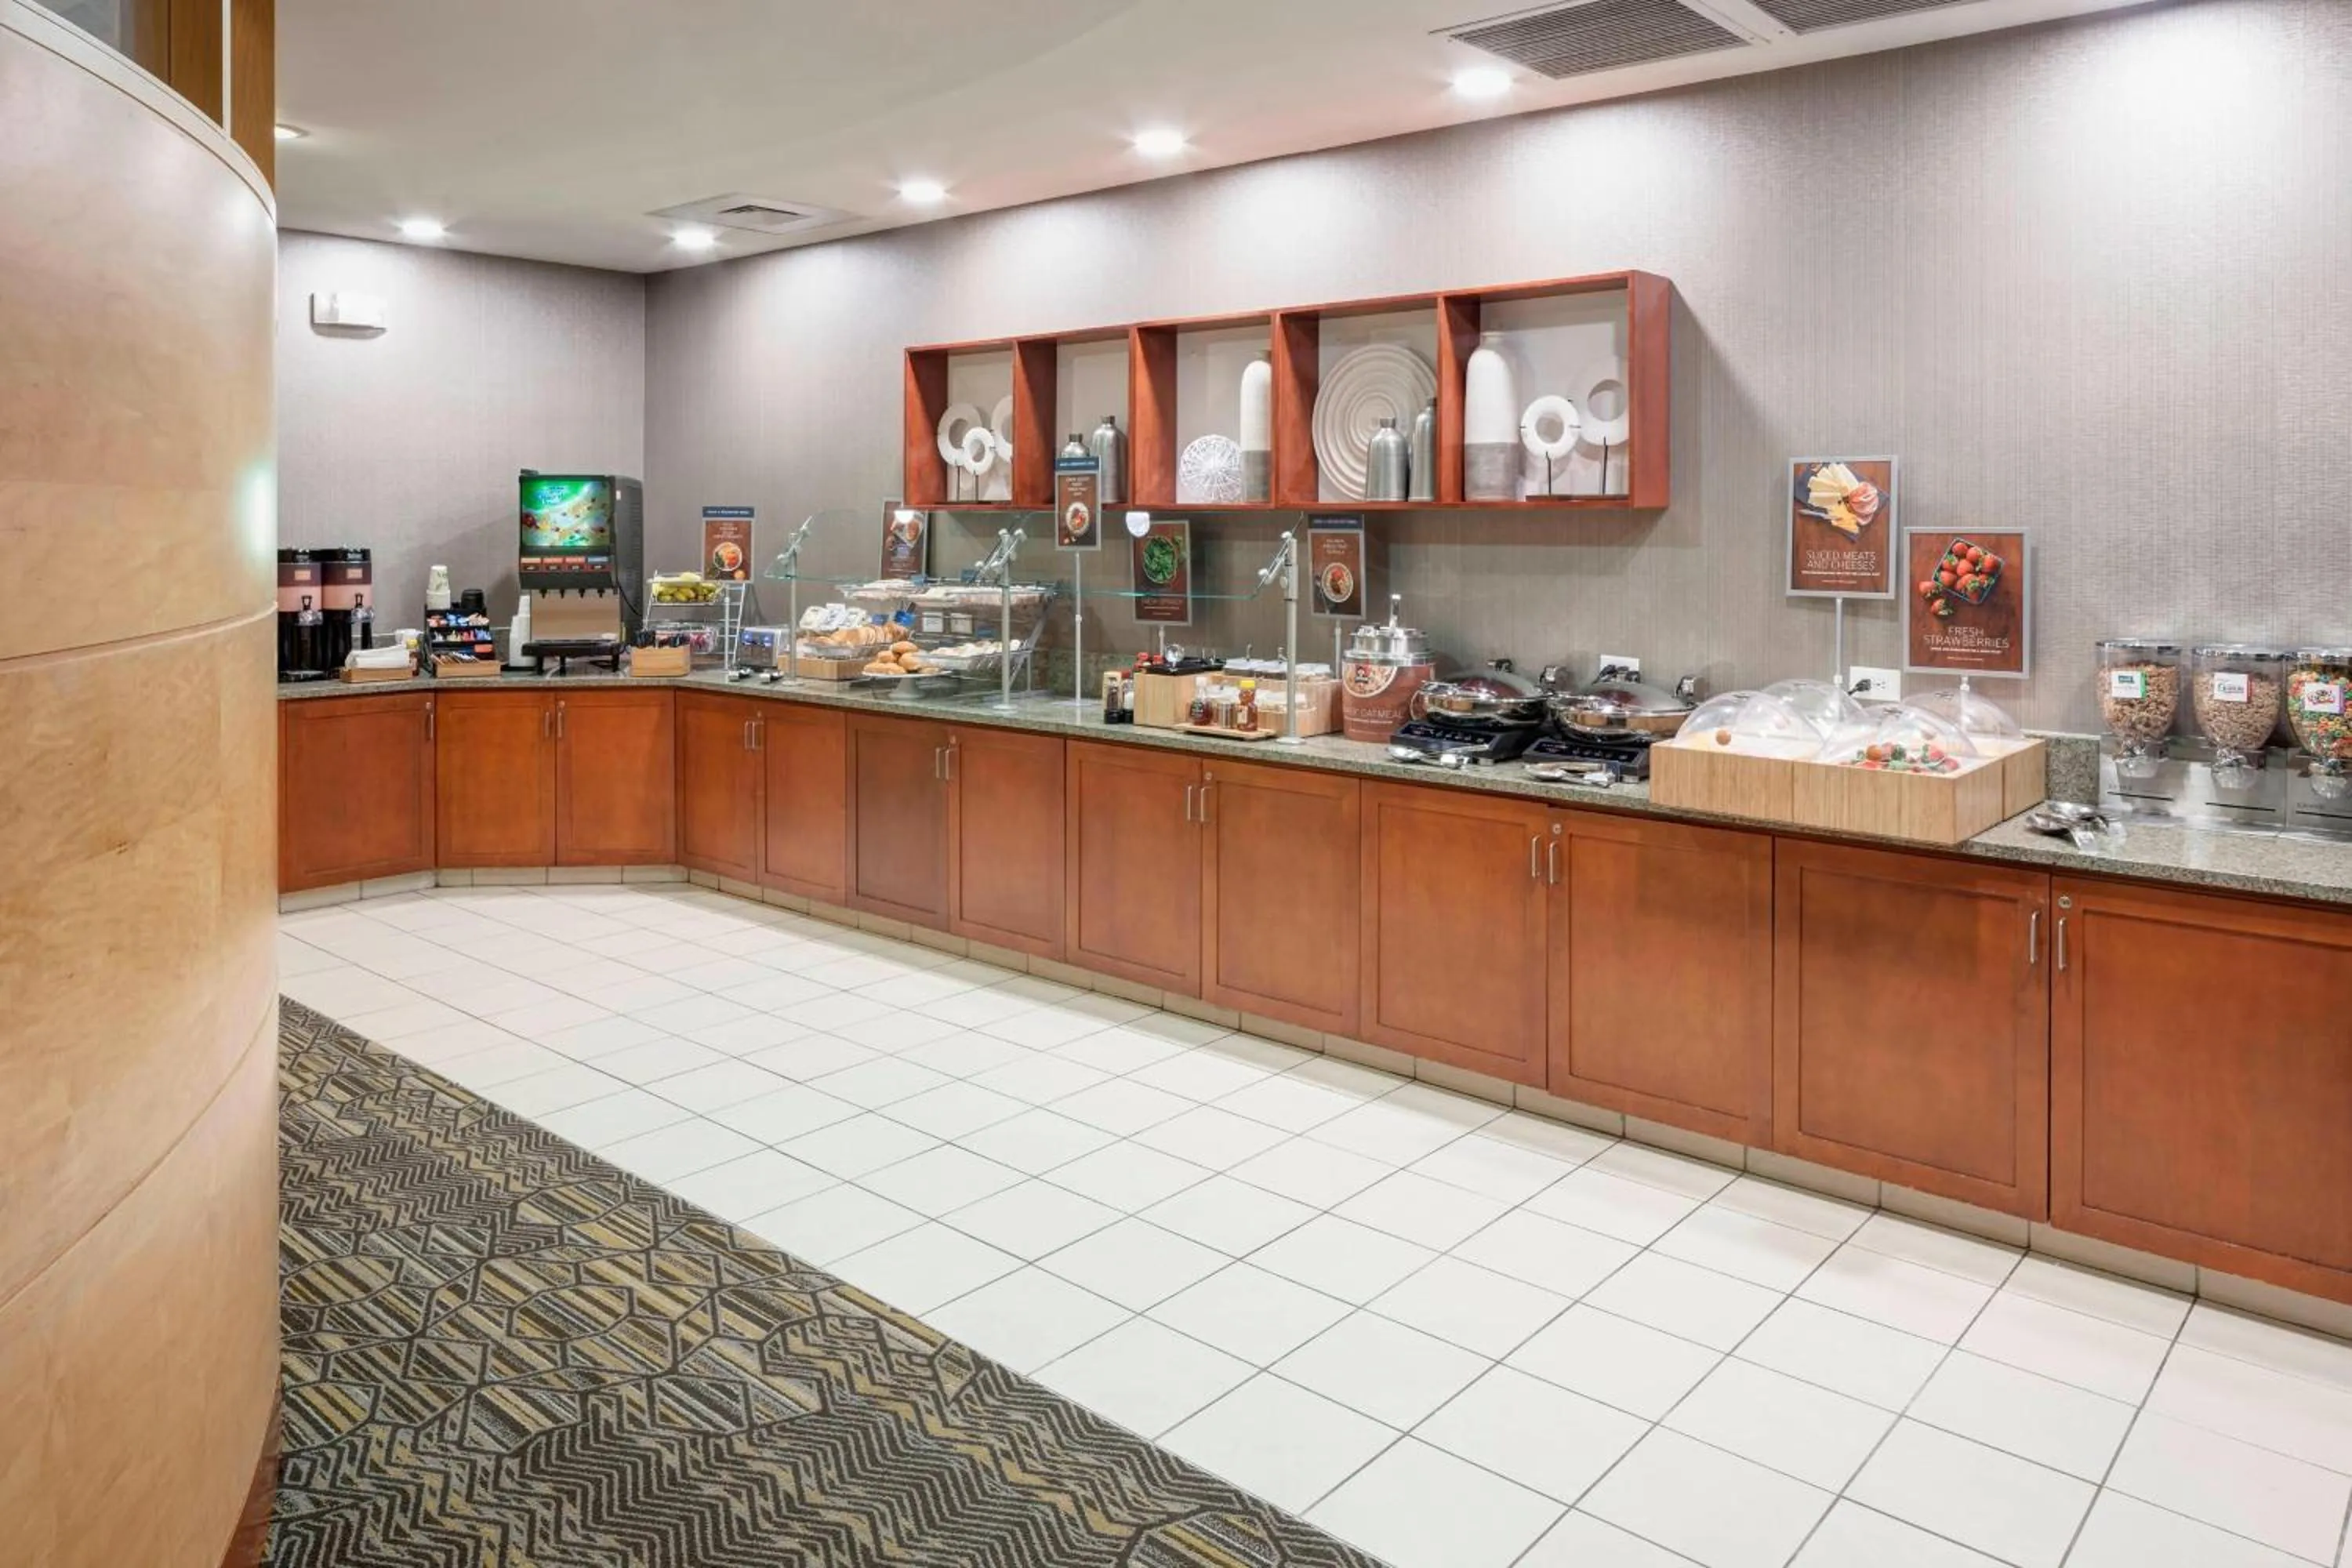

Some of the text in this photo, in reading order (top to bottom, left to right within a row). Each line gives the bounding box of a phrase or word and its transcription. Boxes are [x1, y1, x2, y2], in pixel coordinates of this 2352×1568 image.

[1806, 550, 1876, 561] SLICED MEATS
[1806, 560, 1876, 572] AND CHEESES
[1948, 626, 1984, 637] FRESH
[1923, 634, 2010, 649] STRAWBERRIES
